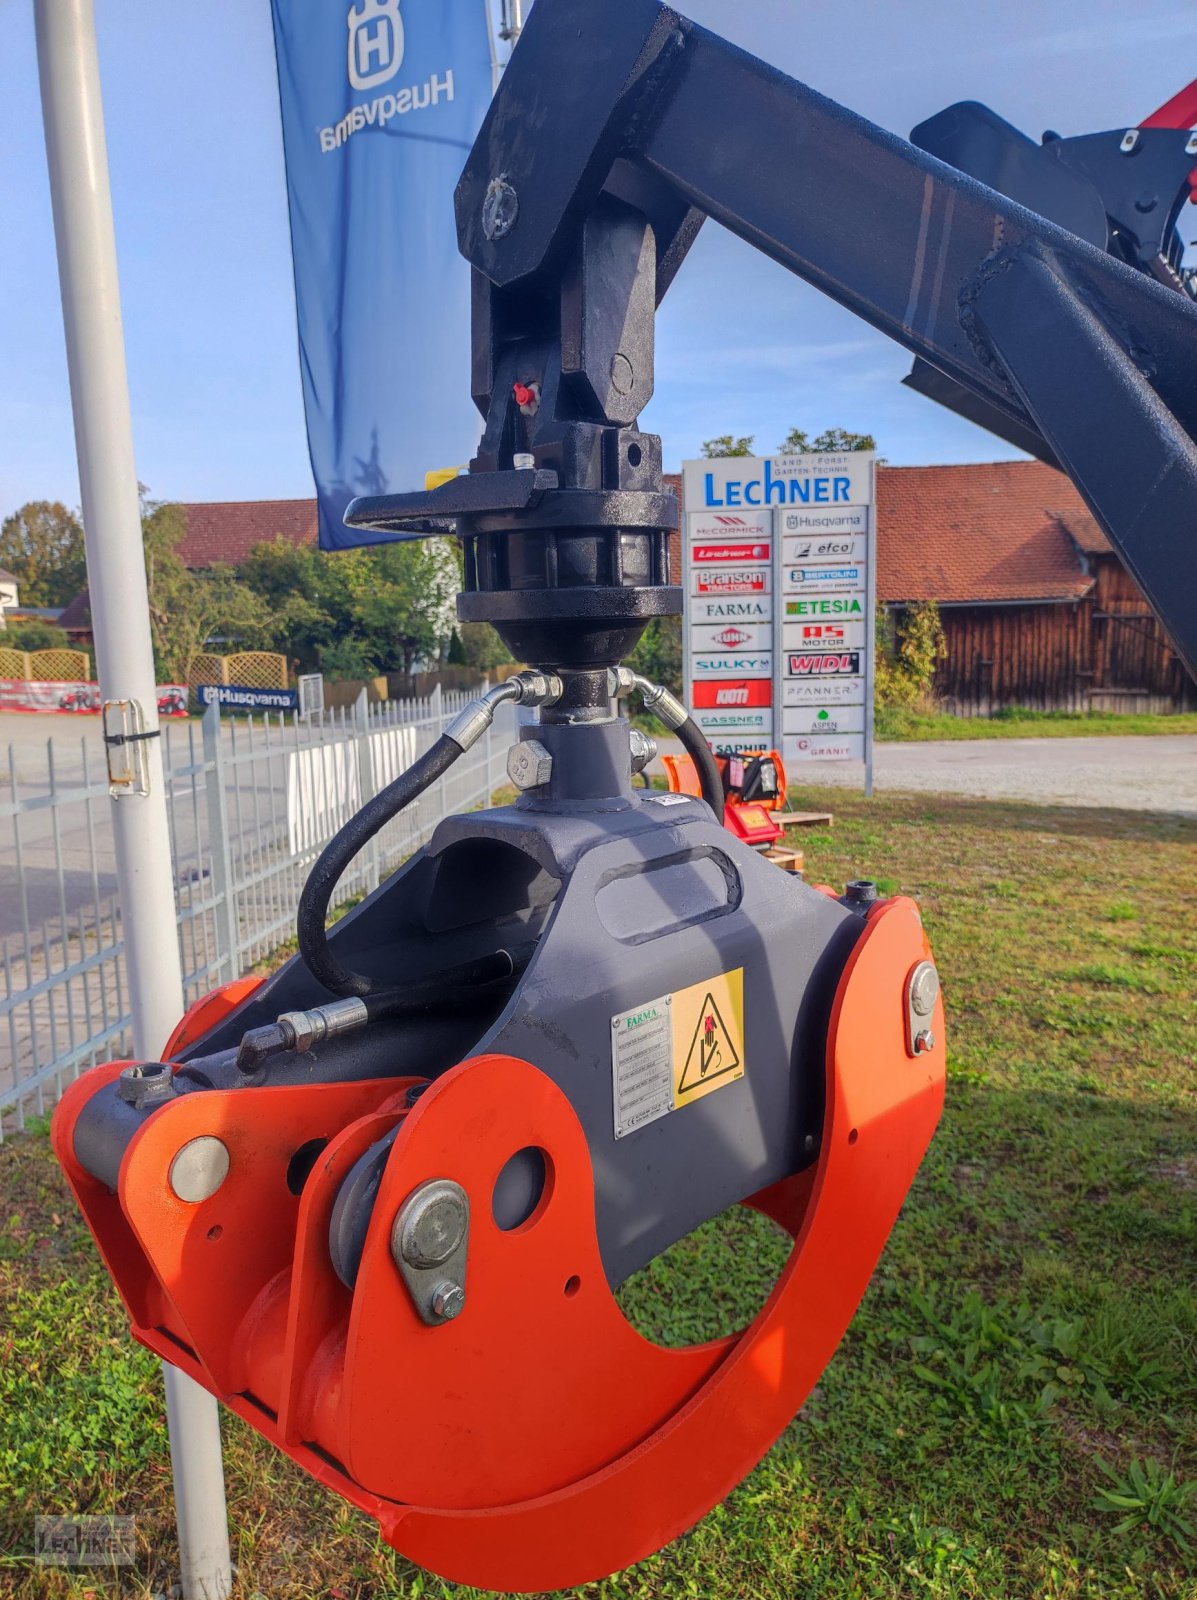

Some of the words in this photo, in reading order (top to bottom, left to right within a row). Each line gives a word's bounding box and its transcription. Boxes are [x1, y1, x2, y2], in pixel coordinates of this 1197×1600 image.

[799, 515, 861, 529] Husqvarna
[818, 542, 849, 554] efco
[700, 571, 764, 586] Branson
[804, 570, 858, 580] BERTOLINI
[705, 603, 764, 617] FARMA
[797, 599, 862, 615] ETESIA
[714, 631, 749, 644] KUHN
[802, 639, 844, 647] MOTOR
[696, 660, 758, 670] SULKY
[790, 655, 853, 675] WIDL
[787, 686, 851, 696] PFANNER
[219, 688, 291, 707] Husqvarna
[700, 716, 763, 725] GASSNER
[811, 721, 838, 729] ASPEN
[716, 744, 768, 755] SAPHIR
[810, 748, 851, 756] GRANIT
[627, 1008, 657, 1030] FARMA
